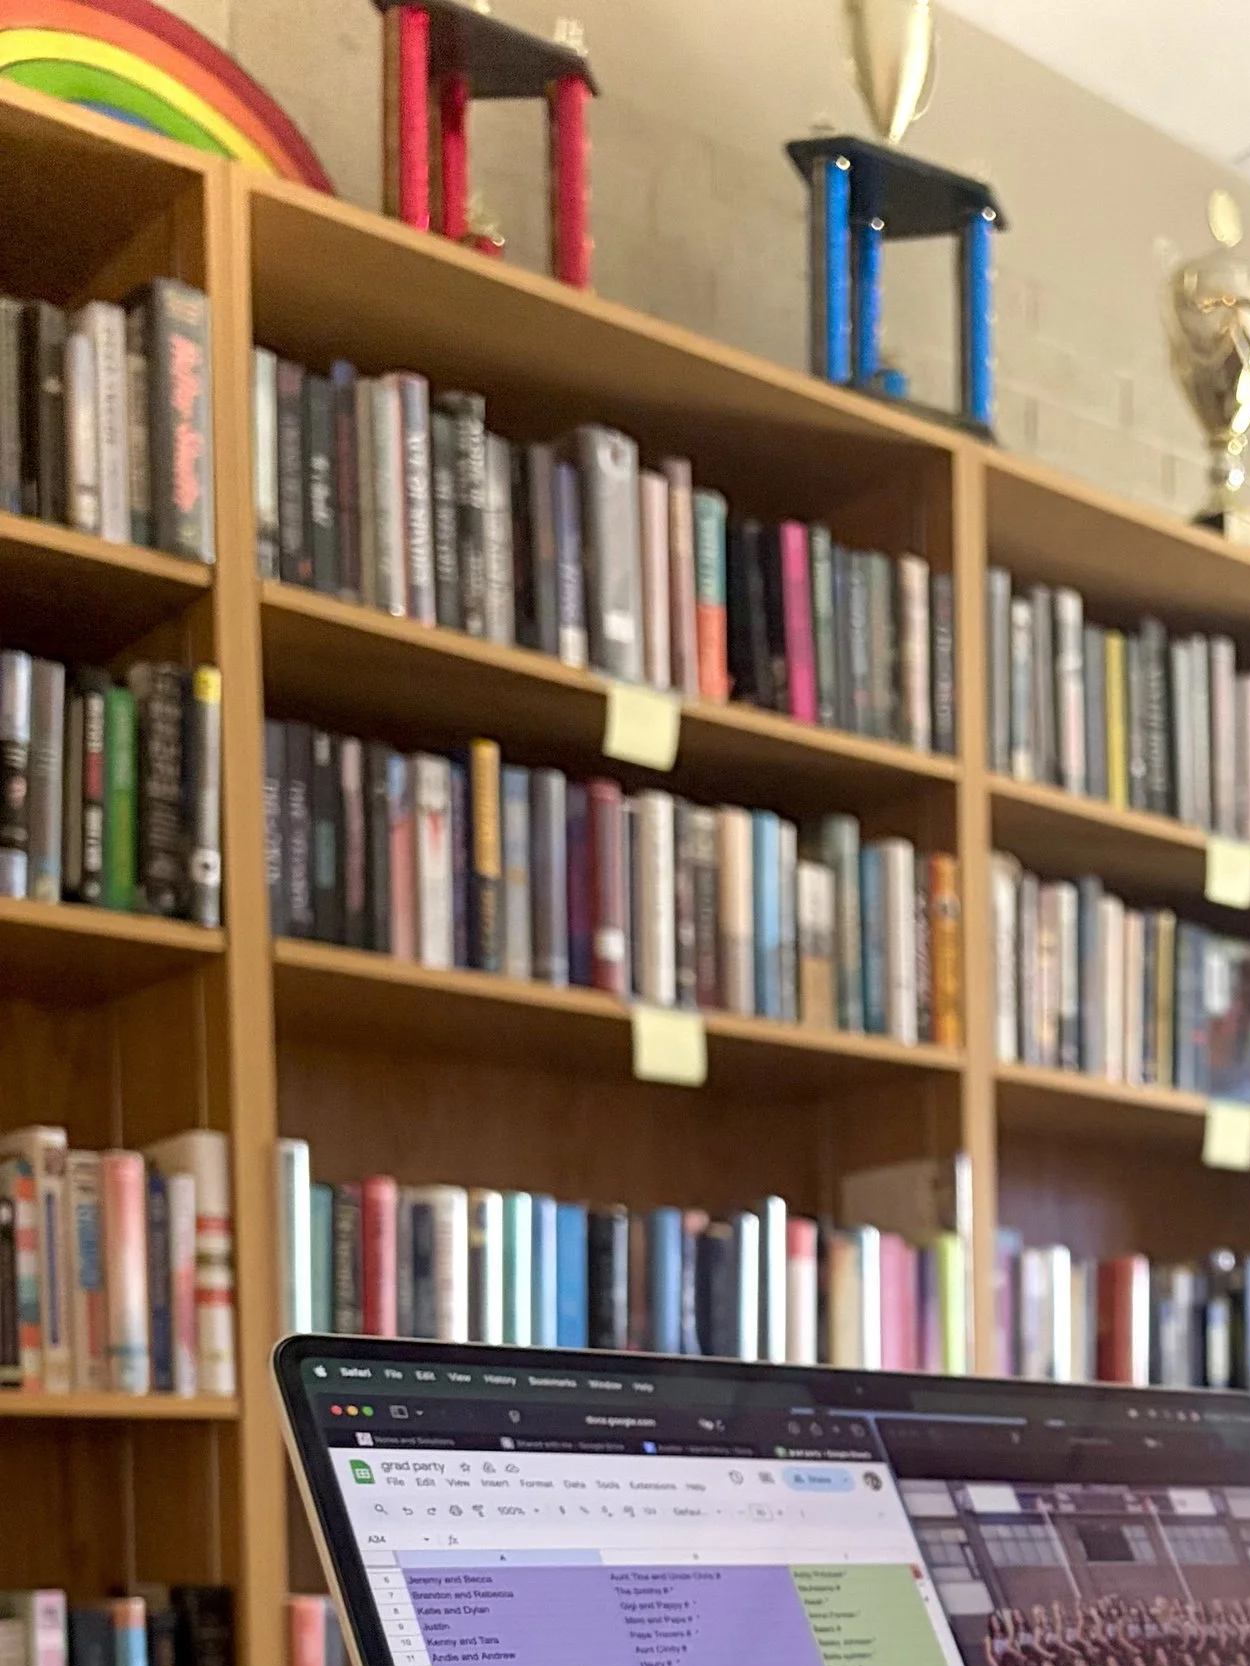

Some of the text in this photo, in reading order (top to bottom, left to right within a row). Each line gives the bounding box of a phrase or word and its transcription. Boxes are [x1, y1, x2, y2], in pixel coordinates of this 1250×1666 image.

[339, 1367, 372, 1378] Safari
[384, 1368, 403, 1380] File
[415, 1369, 436, 1381] Edit
[448, 1372, 471, 1383] View
[483, 1374, 517, 1386] History
[381, 1461, 445, 1475] grad party
[387, 1478, 405, 1487] File
[416, 1478, 436, 1487] Edit
[446, 1479, 470, 1488] View
[480, 1479, 510, 1488] Insert
[520, 1480, 554, 1488] Format
[563, 1480, 587, 1489] Data
[595, 1480, 620, 1490] Tools
